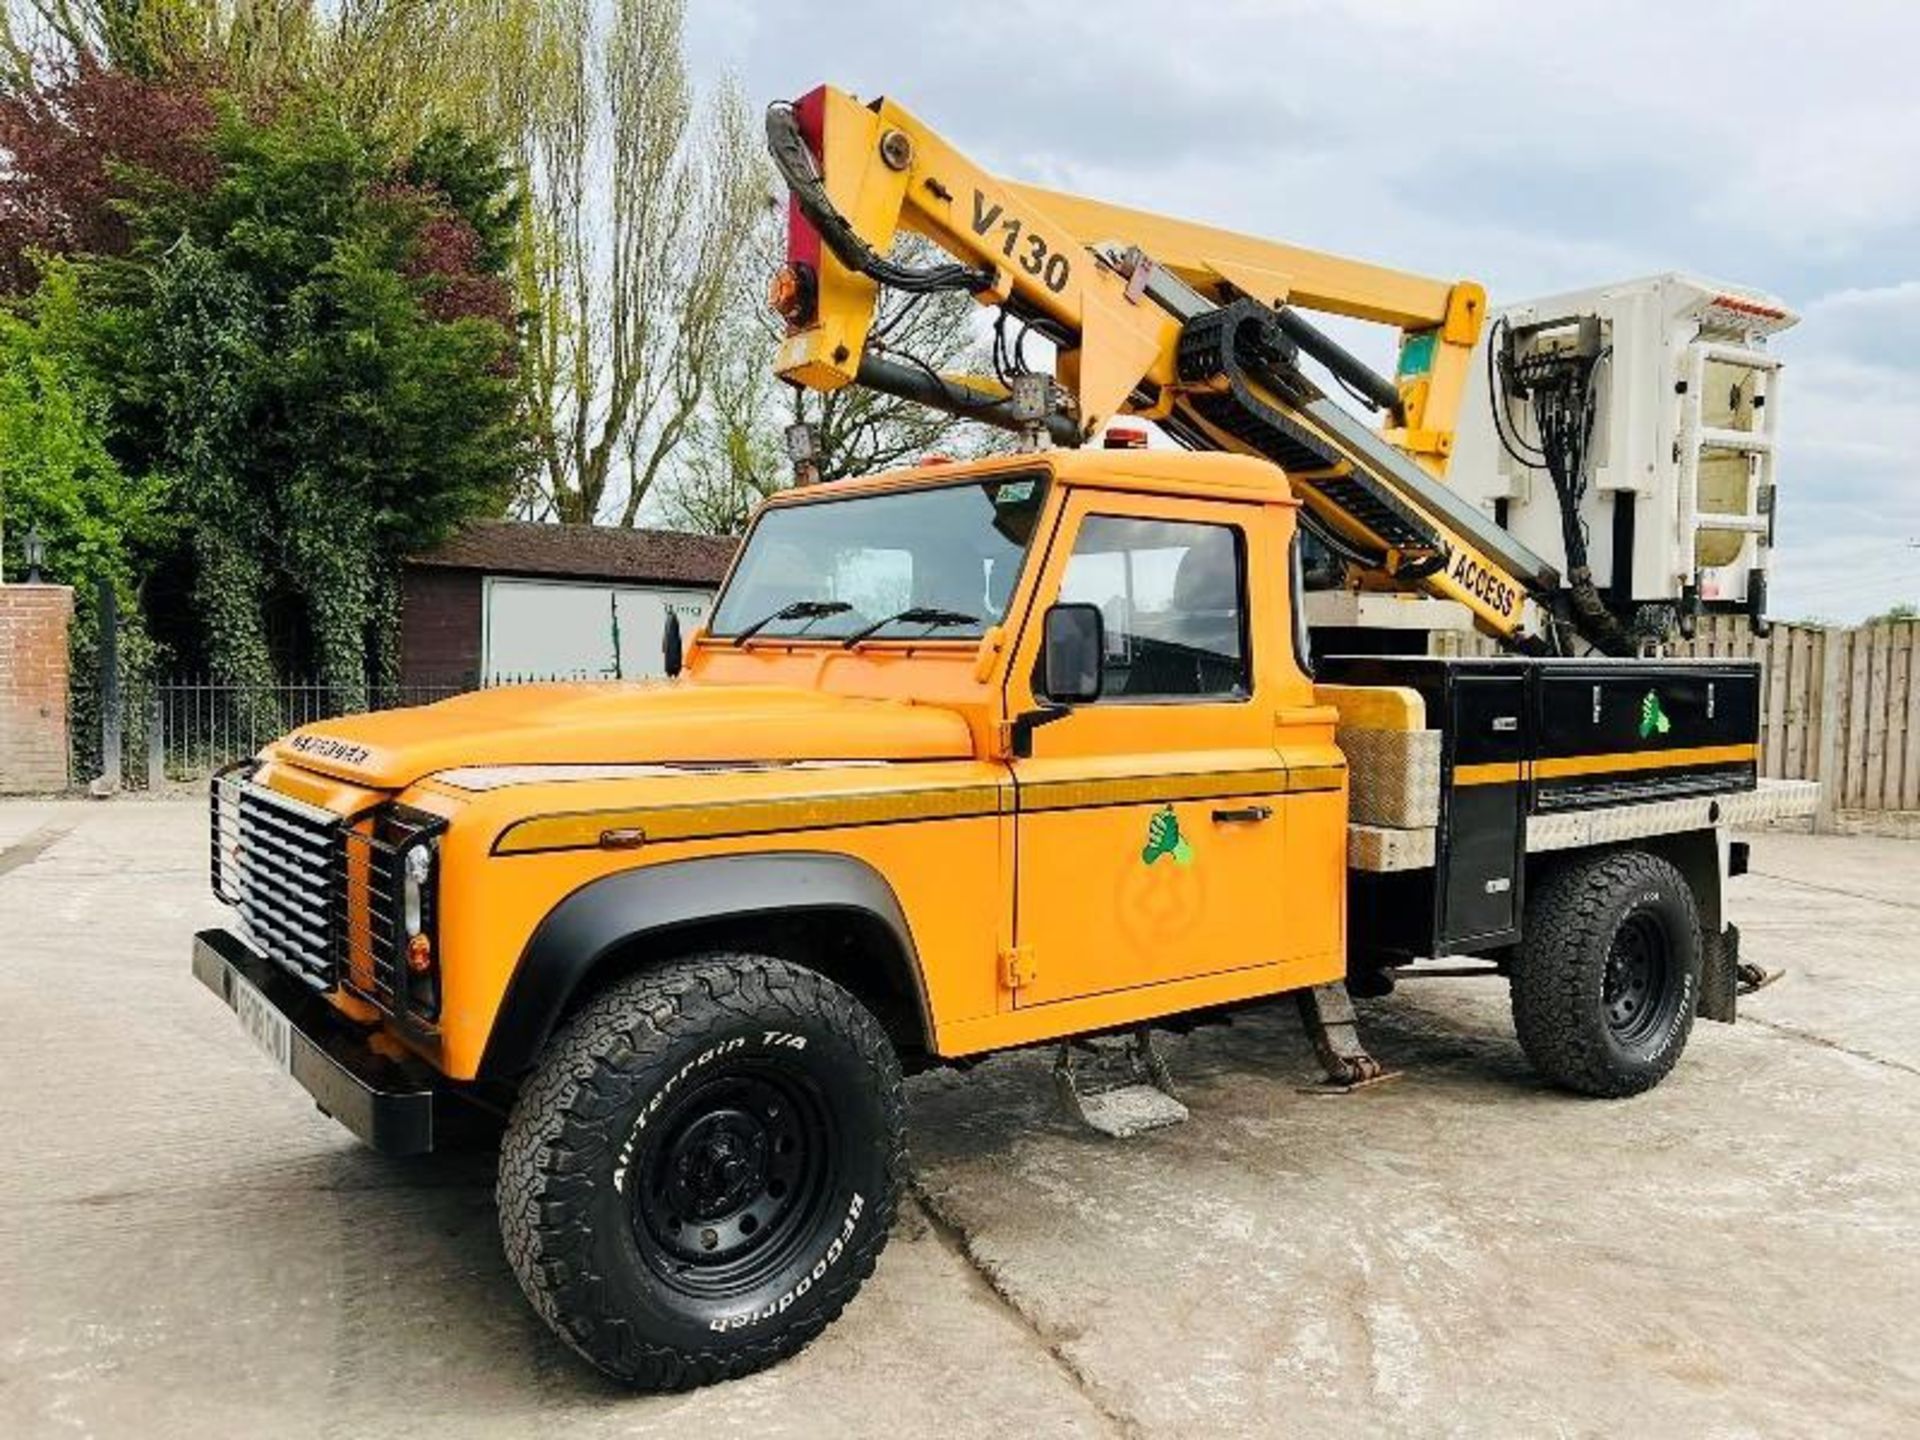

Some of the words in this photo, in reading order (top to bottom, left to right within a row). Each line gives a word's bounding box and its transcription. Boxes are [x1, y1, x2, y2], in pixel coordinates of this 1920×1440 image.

[971, 188, 1070, 294] V130
[1451, 553, 1516, 618] ACCESS
[762, 1031, 808, 1050] T/A
[709, 1192, 865, 1333] BFGoodrich
